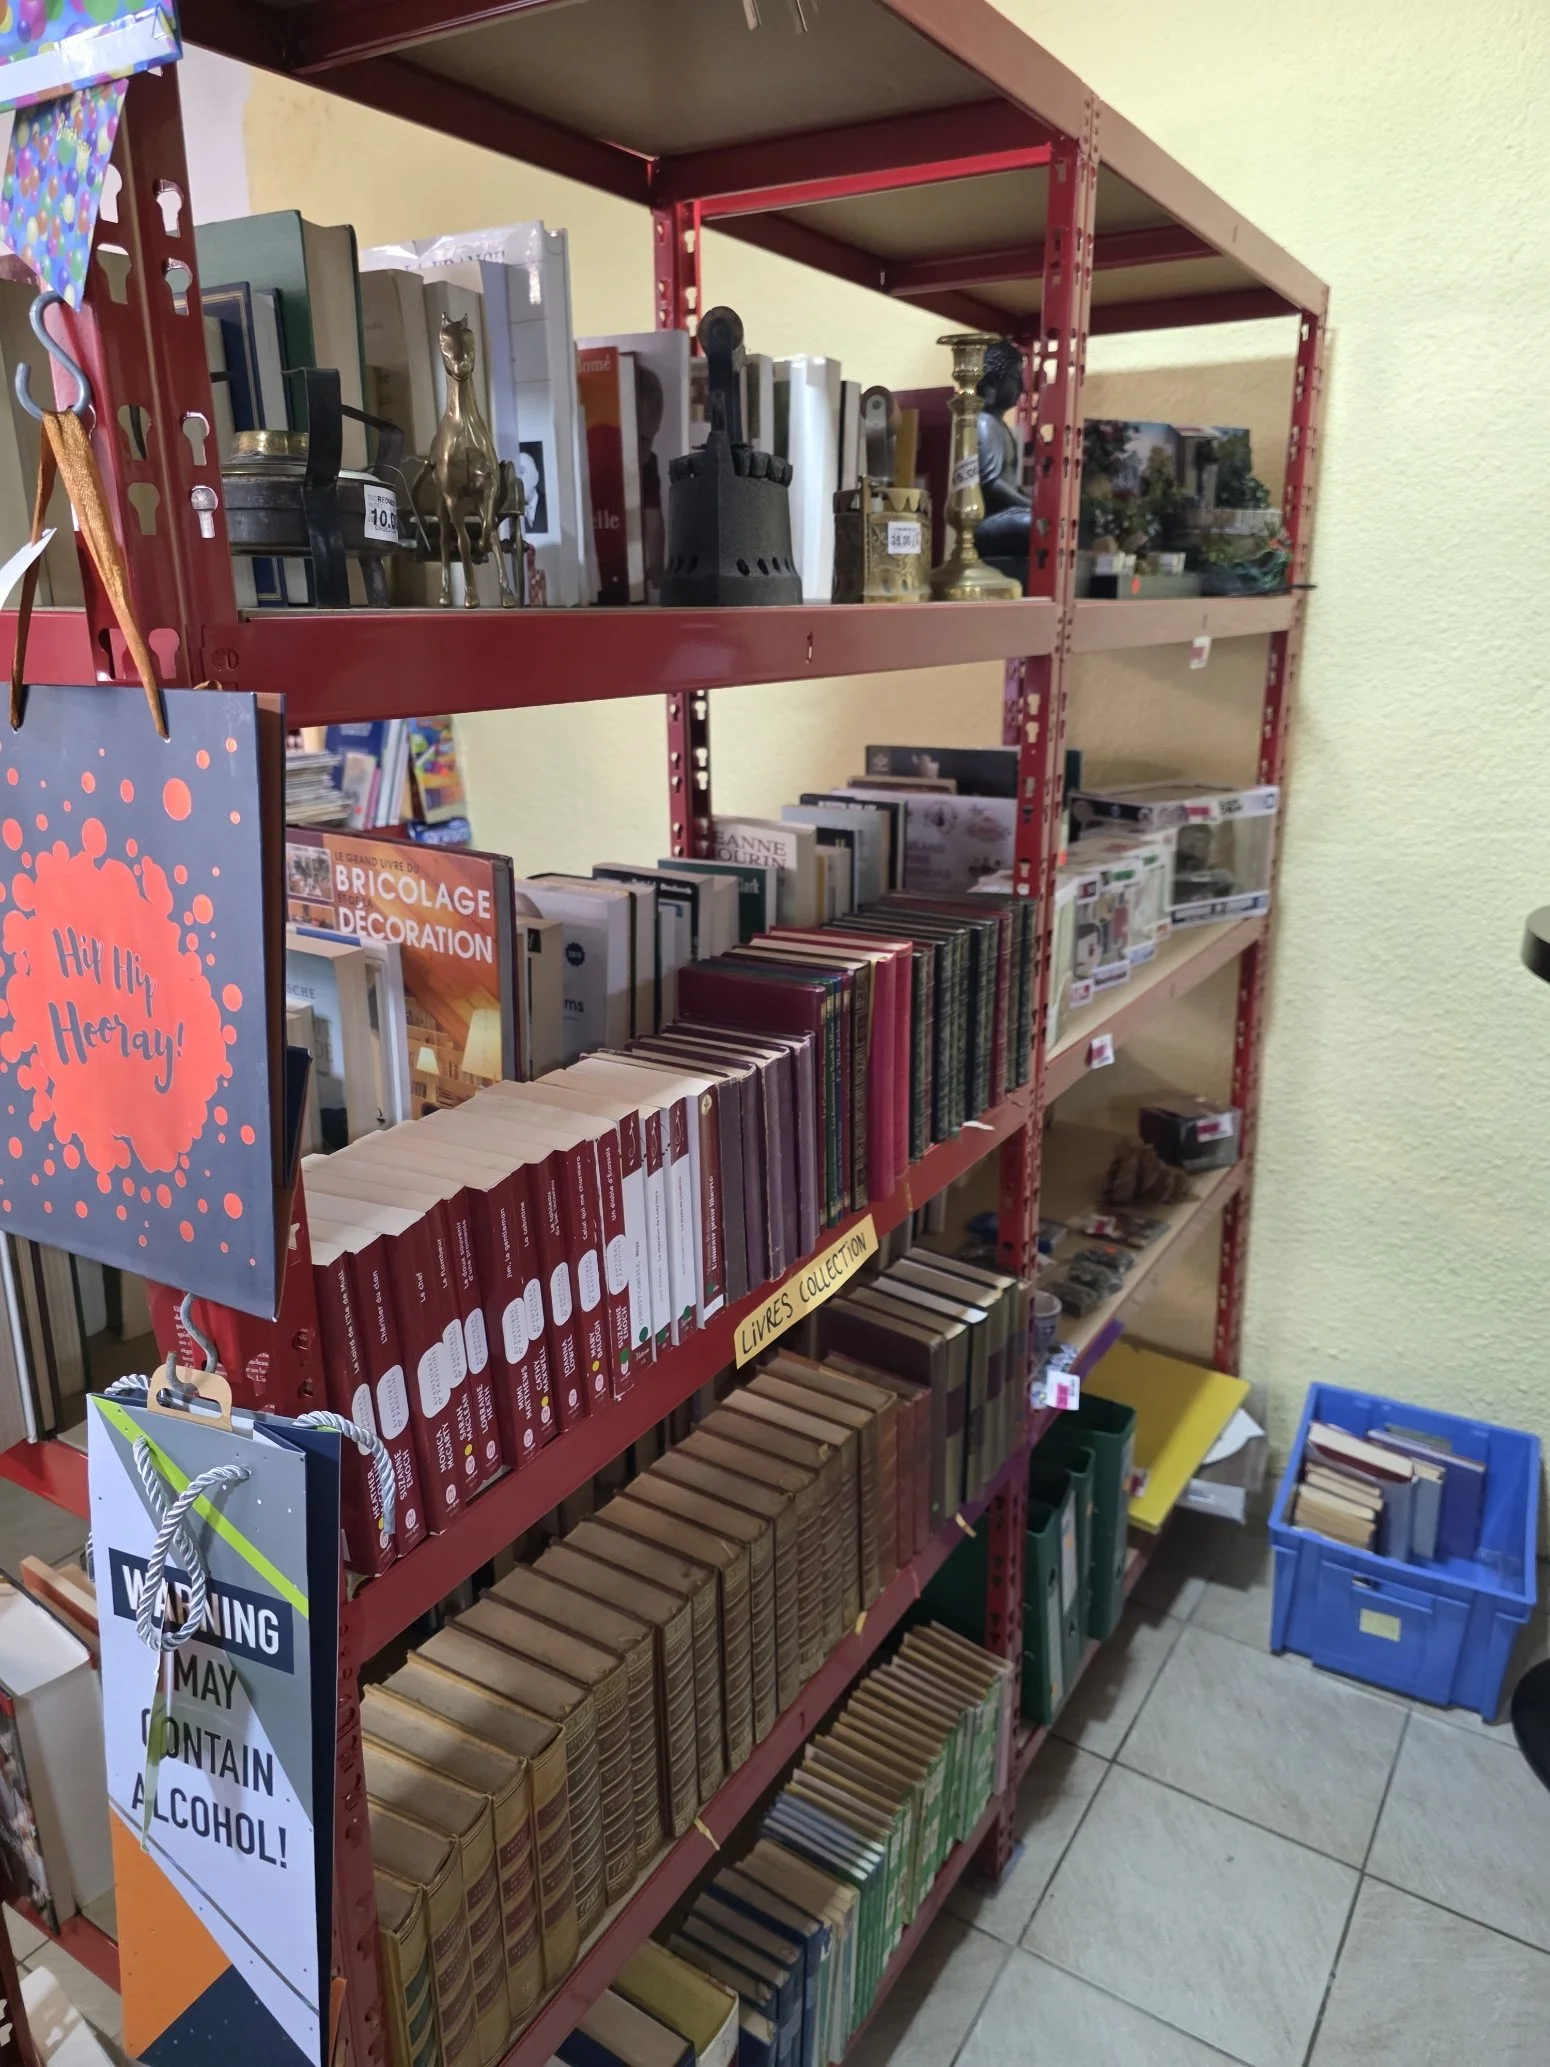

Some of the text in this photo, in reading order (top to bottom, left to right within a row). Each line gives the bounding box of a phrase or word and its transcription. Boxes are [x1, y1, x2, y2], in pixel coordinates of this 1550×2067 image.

[371, 508, 398, 530] 10.0
[715, 830, 787, 858] EANNE
[718, 847, 787, 873] OURIN
[334, 851, 420, 874] LE GRAND LIVRE DU
[335, 864, 491, 920] BRICOLAGE
[738, 877, 760, 894] lark
[338, 902, 494, 964] DÉCORATION
[52, 926, 158, 1019] Hip Hip
[47, 1000, 184, 1095] Hooray!
[576, 1155, 584, 1192] charmera
[580, 1194, 585, 1206] me
[608, 1185, 616, 1209] diable
[500, 1207, 510, 1252] gentleman
[520, 1201, 530, 1248] La cabotine
[611, 1209, 617, 1221] Un
[456, 1221, 465, 1256] souvenir
[462, 1219, 471, 1258] promesse
[337, 1268, 347, 1293] Mull
[372, 1269, 380, 1290] clan
[437, 1238, 448, 1289] Le flambeur
[342, 1291, 348, 1305] de
[375, 1291, 382, 1304] du
[415, 1271, 426, 1303] Le chef
[464, 1278, 469, 1290] Le
[348, 1325, 354, 1338] de
[594, 1319, 604, 1360] BALOGH
[615, 1305, 625, 1349] SUZANNE
[621, 1306, 629, 1340] ENOCH
[349, 1337, 358, 1362] laird
[567, 1333, 576, 1373] LOWELL
[589, 1332, 597, 1358] MARY
[353, 1360, 360, 1375] Le
[534, 1360, 543, 1391] CATHY
[539, 1345, 549, 1394] MAXWELL
[476, 1384, 489, 1434] LORRAINE
[483, 1386, 494, 1421] HEATH
[521, 1364, 533, 1420] MATTHEWS
[456, 1405, 465, 1441] SARAH
[402, 1449, 414, 1489] ENOCH
[436, 1429, 447, 1474] MONICA
[393, 1449, 408, 1501] SUZANNE
[367, 1470, 379, 1520] HEATHER
[173, 1647, 238, 1710] MAY
[131, 1772, 288, 1869] ALCOHOL!
